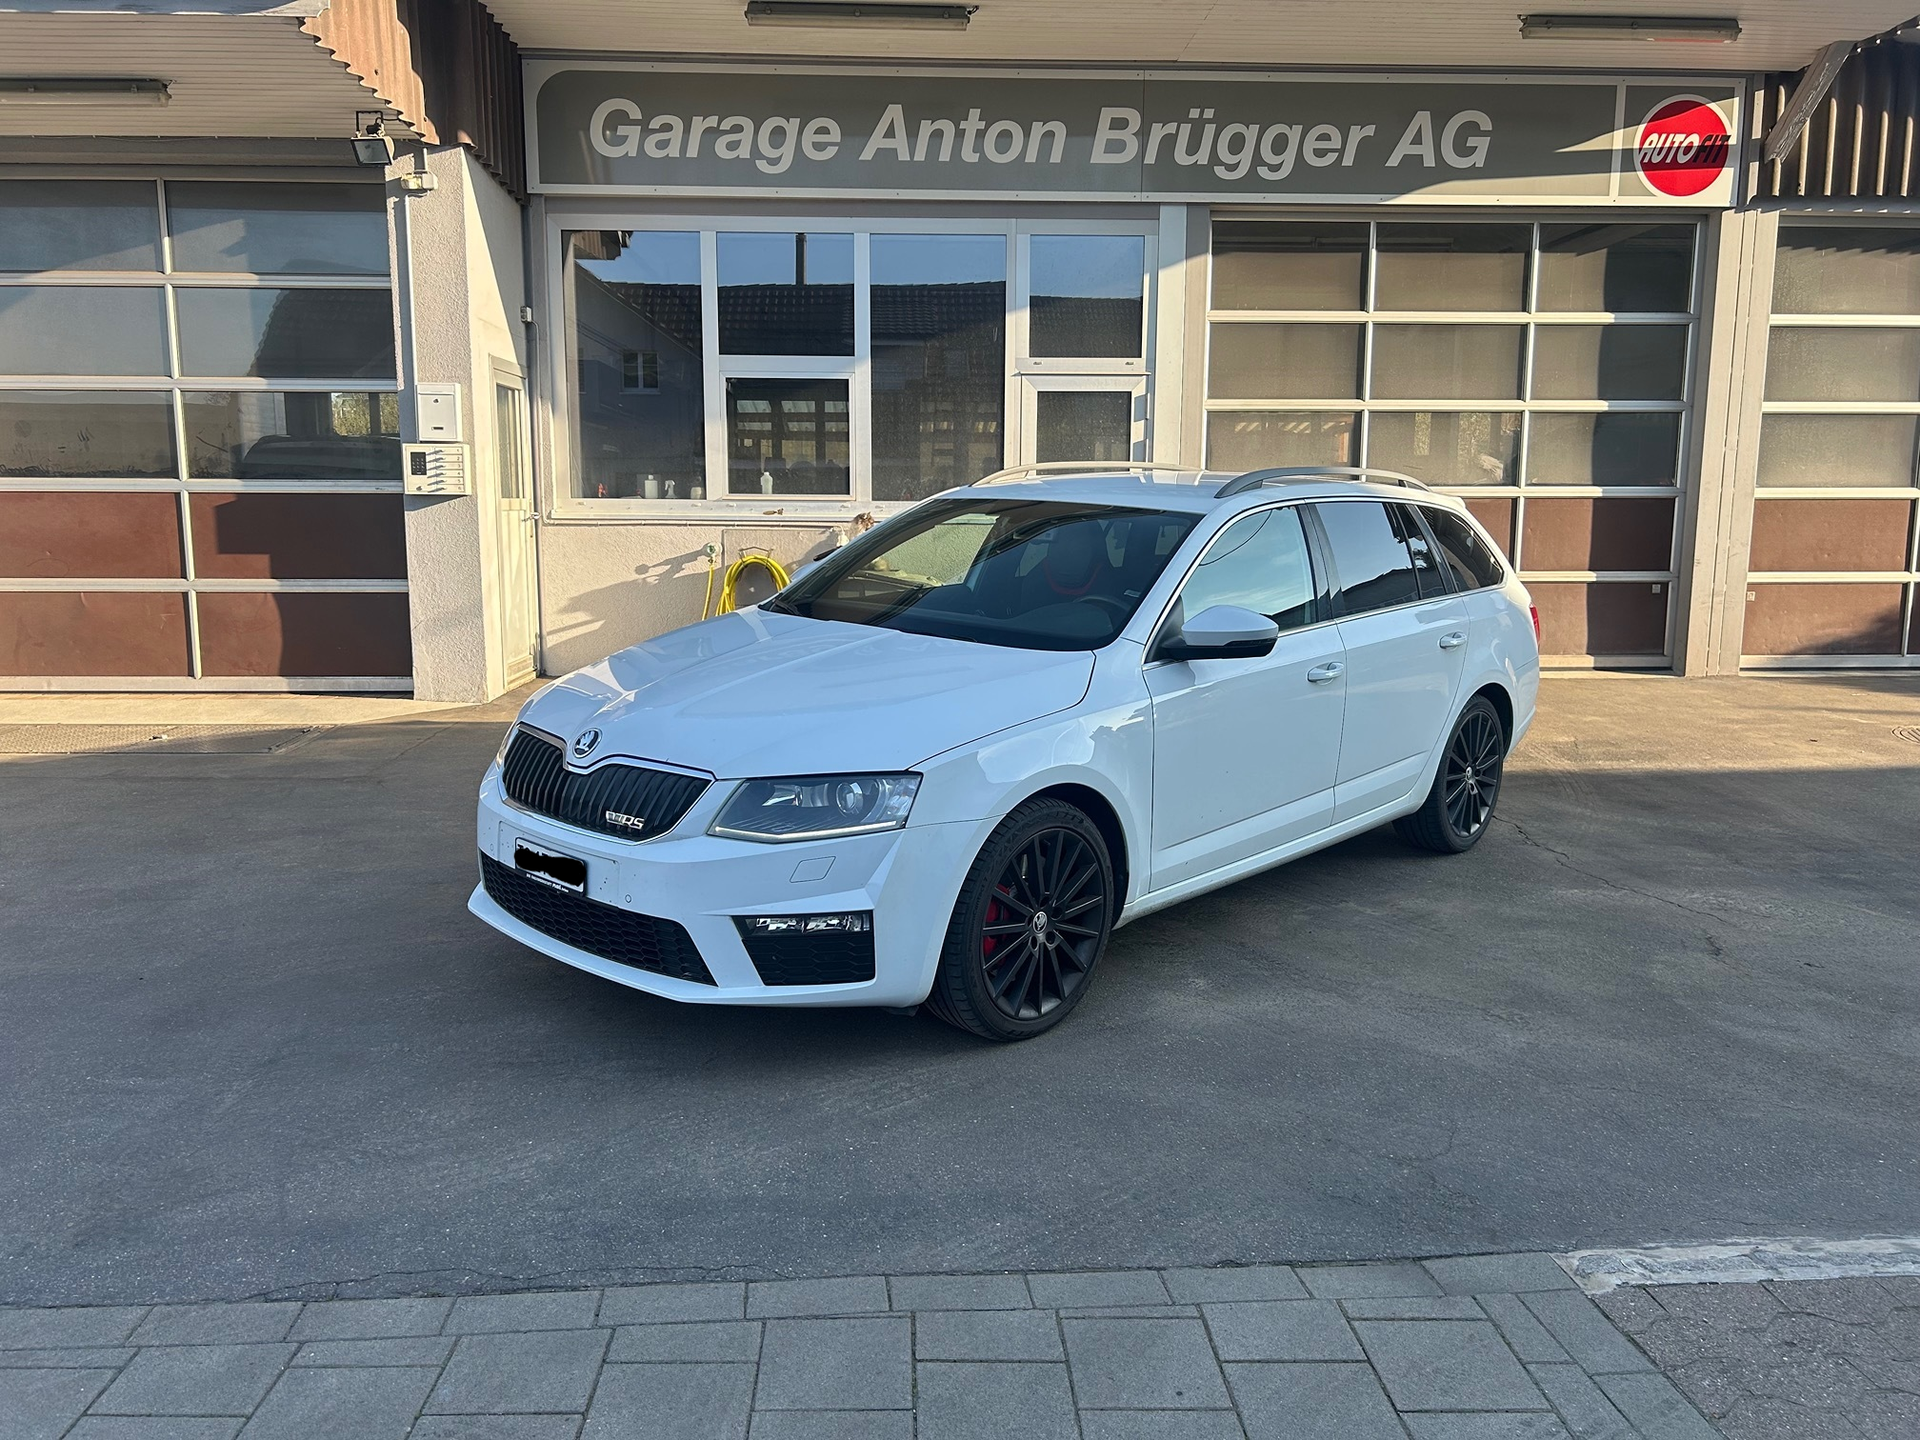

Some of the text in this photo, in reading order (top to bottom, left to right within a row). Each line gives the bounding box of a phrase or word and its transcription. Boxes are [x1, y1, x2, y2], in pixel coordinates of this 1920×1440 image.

[589, 97, 1494, 180] Garage Anton Brügger AG
[1639, 132, 1732, 164] AUTOFIT
